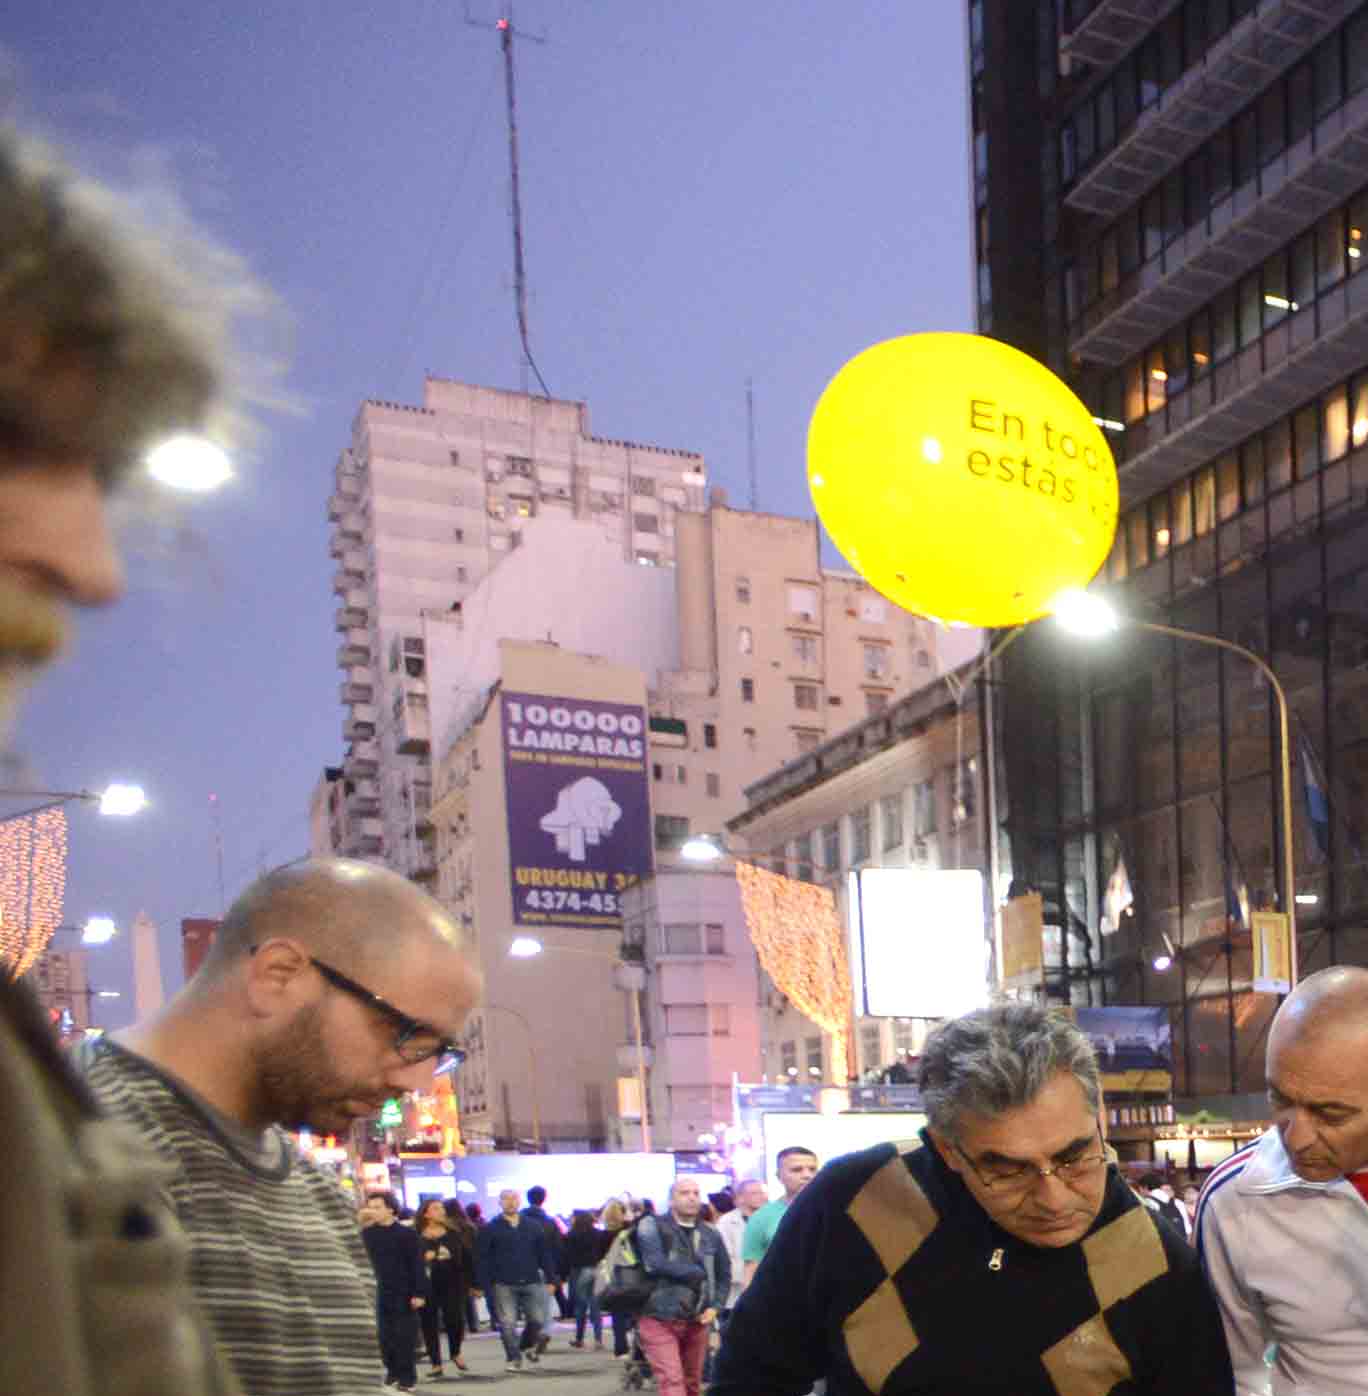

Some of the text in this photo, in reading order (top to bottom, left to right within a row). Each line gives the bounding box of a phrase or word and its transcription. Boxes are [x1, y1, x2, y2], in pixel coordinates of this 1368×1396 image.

[970, 399, 1024, 441] En
[967, 450, 1075, 503] estás
[507, 703, 643, 735] 100000
[515, 866, 609, 891] URUGUAY
